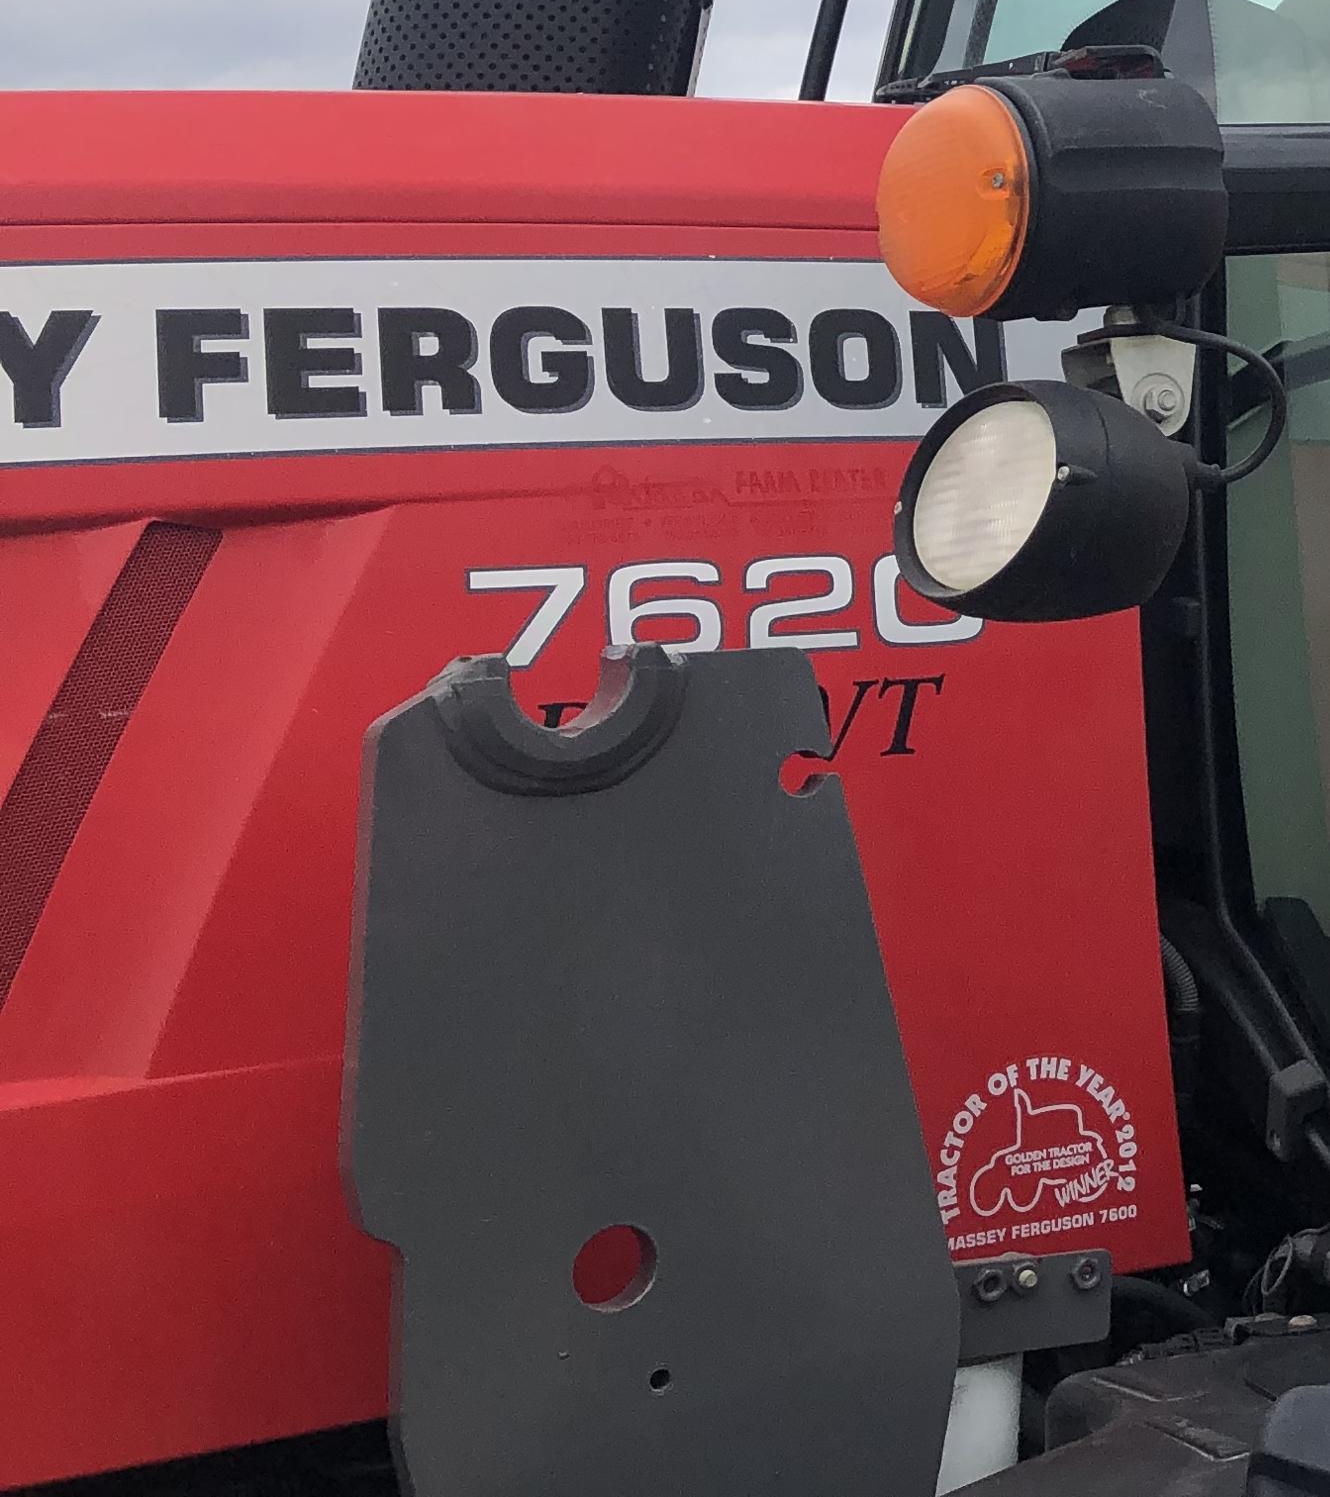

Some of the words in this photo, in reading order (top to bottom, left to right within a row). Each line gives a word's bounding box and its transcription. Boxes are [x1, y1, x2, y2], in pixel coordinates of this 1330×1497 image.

[156, 305, 1007, 423] FERGUSON
[937, 1093, 987, 1225] TRACTOR
[987, 1065, 1018, 1096] OF
[1026, 1057, 1072, 1081] THE
[1115, 1123, 1138, 1192] 2012
[1005, 1149, 1047, 1166] GOLDEN
[1048, 1141, 1093, 1157] TRACTOR
[1011, 1164, 1031, 1176] FOR
[1033, 1159, 1051, 1172] THE
[1053, 1153, 1090, 1169] DESIGN
[1054, 1159, 1119, 1208] WINNER
[1011, 1212, 1094, 1240] FERGUSON
[1099, 1204, 1137, 1223] 7600
